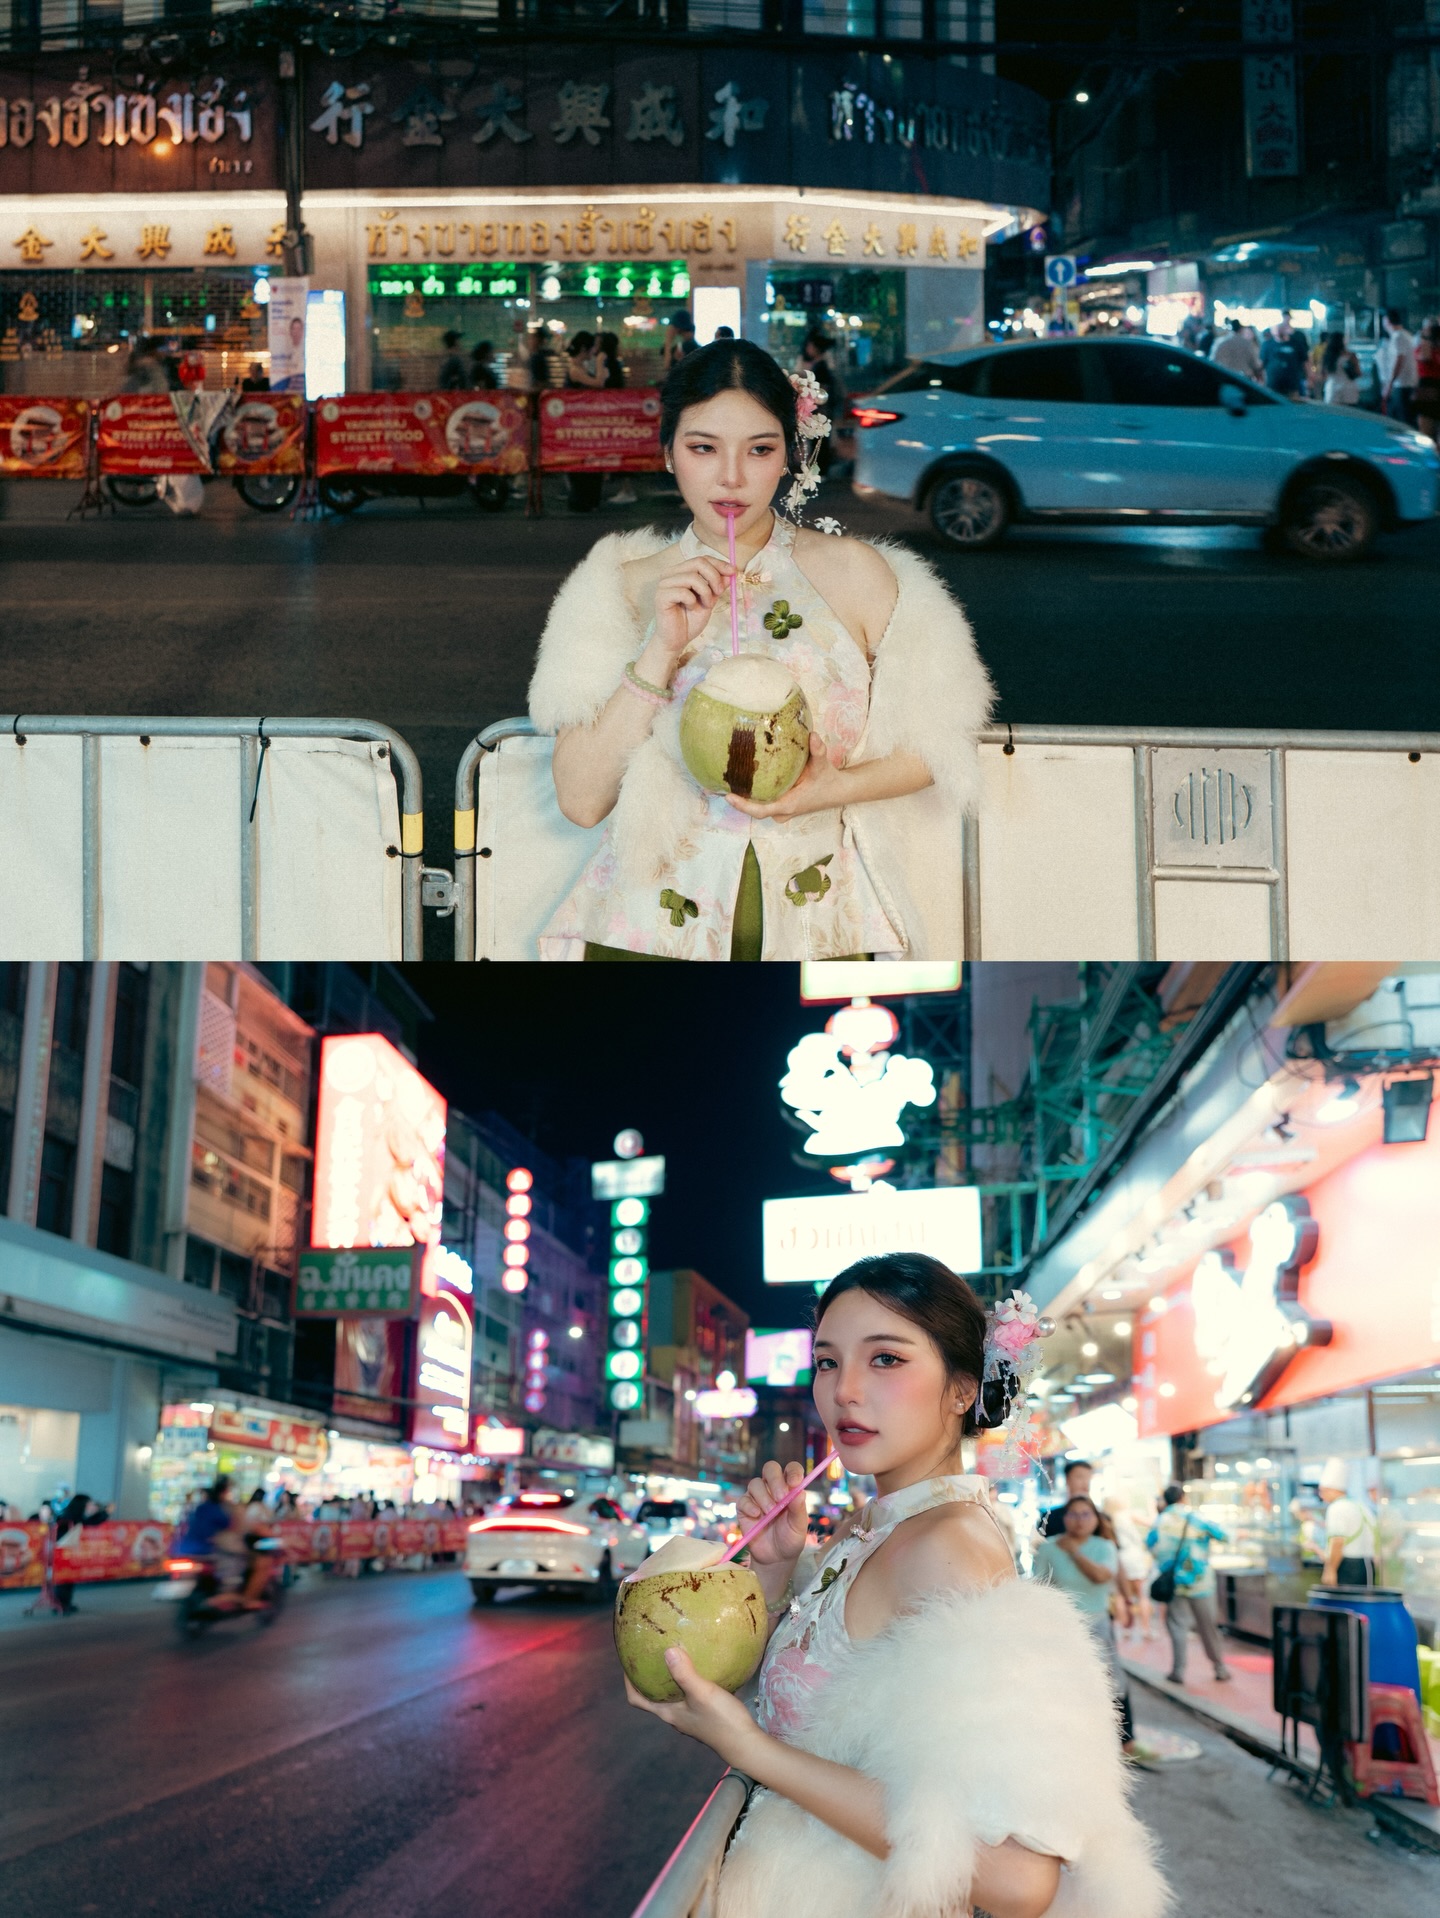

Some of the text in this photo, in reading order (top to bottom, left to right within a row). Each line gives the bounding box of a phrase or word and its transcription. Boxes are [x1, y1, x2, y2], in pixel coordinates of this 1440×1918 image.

[329, 429, 425, 444] STREET FOOD
[555, 426, 653, 440] STREET FOOD
